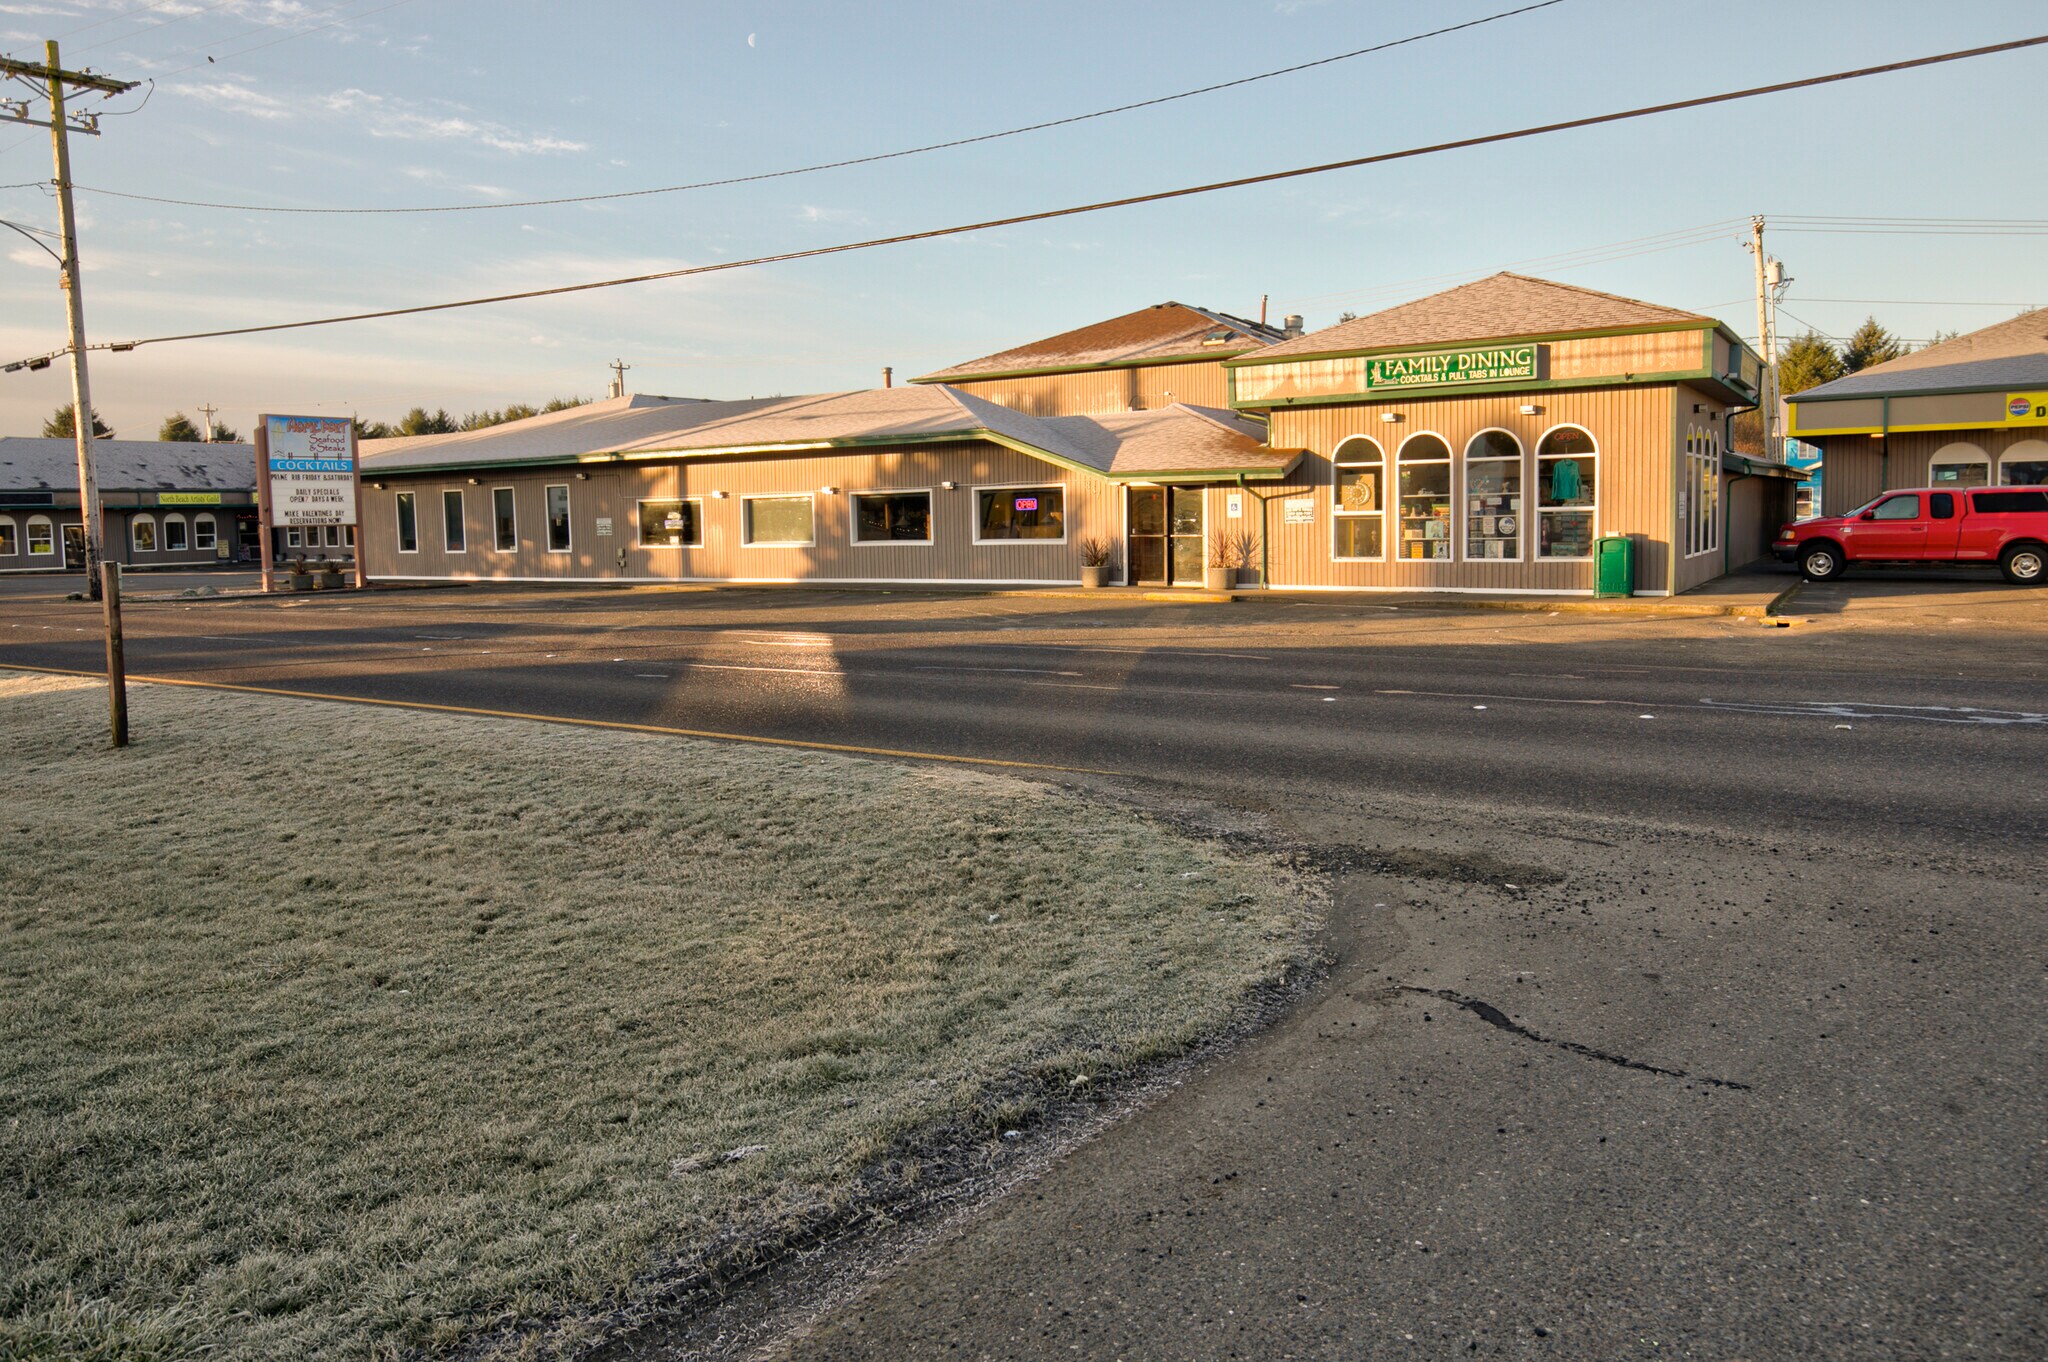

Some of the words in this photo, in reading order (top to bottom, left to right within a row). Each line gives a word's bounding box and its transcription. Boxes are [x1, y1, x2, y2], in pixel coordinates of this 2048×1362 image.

[1385, 355, 1451, 376] FAMILY
[1458, 348, 1531, 371] DINING
[1399, 373, 1439, 384] COCKTAILS
[1449, 371, 1466, 380] PULL
[1469, 369, 1488, 378] TABS
[1490, 368, 1497, 377] IN
[1499, 366, 1531, 377] LOUNGE
[309, 434, 345, 445] Seafood
[1554, 432, 1579, 441] OPEN
[316, 443, 345, 453] Steaks
[277, 461, 348, 471] COCKTAILS
[176, 494, 189, 503] Beach
[207, 494, 220, 502] Guild
[1017, 501, 1036, 509] OPEN
